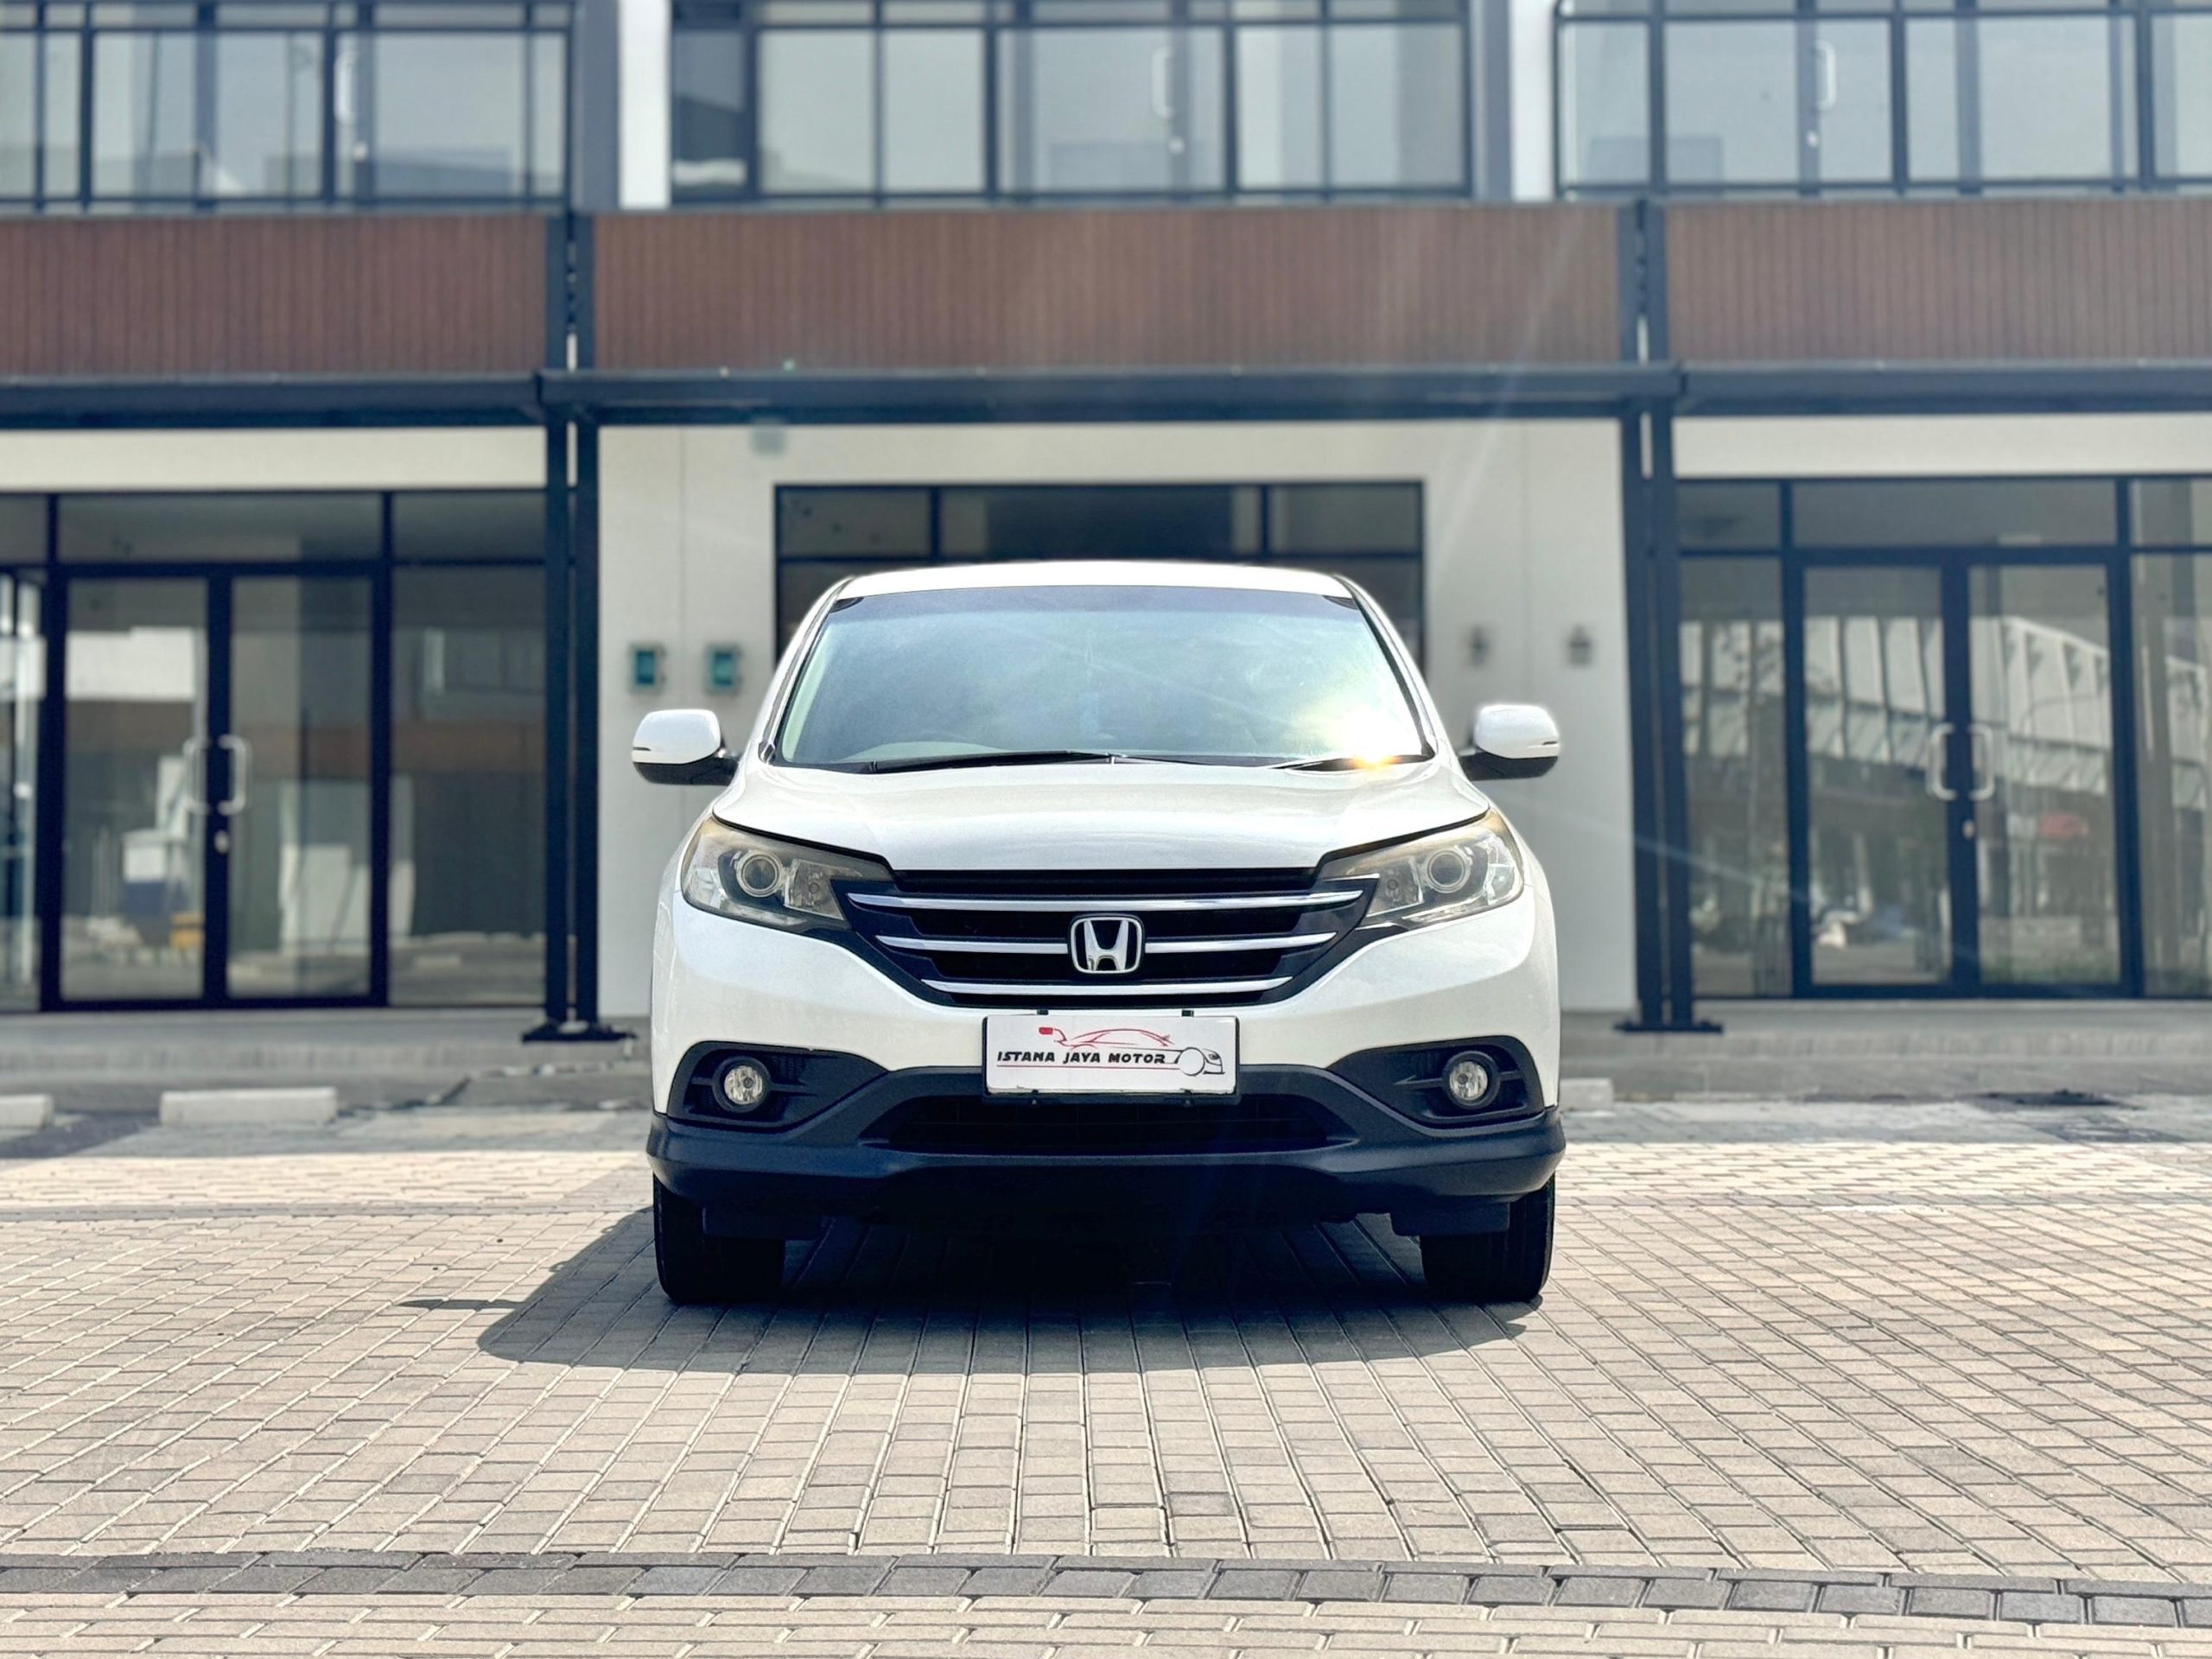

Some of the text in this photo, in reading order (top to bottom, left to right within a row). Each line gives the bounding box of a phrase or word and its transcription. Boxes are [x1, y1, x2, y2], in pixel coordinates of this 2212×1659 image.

[997, 1051, 1166, 1065] ISTANA JAYA MOTOR
